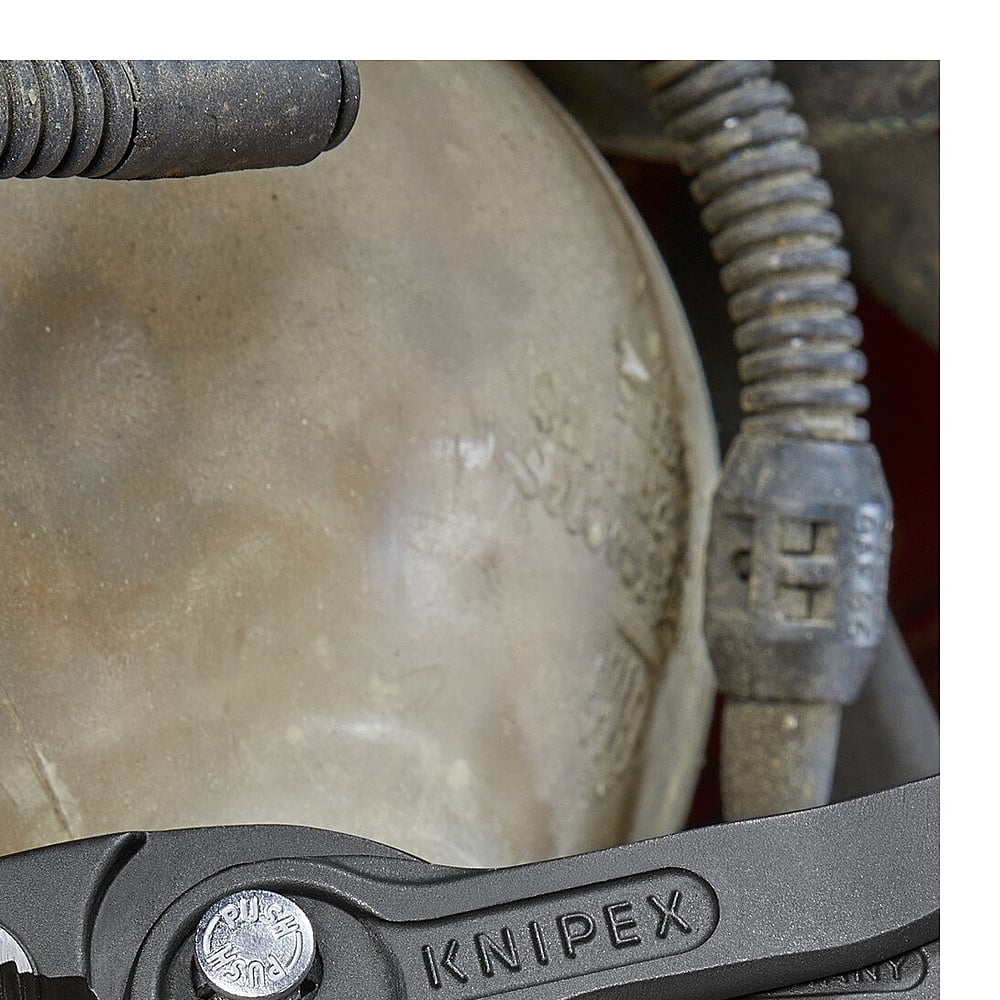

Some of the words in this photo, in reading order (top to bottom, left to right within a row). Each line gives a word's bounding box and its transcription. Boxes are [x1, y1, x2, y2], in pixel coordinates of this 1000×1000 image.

[220, 895, 301, 940] PUSH
[422, 890, 693, 989] KNIPEX
[206, 943, 290, 988] PUSH
